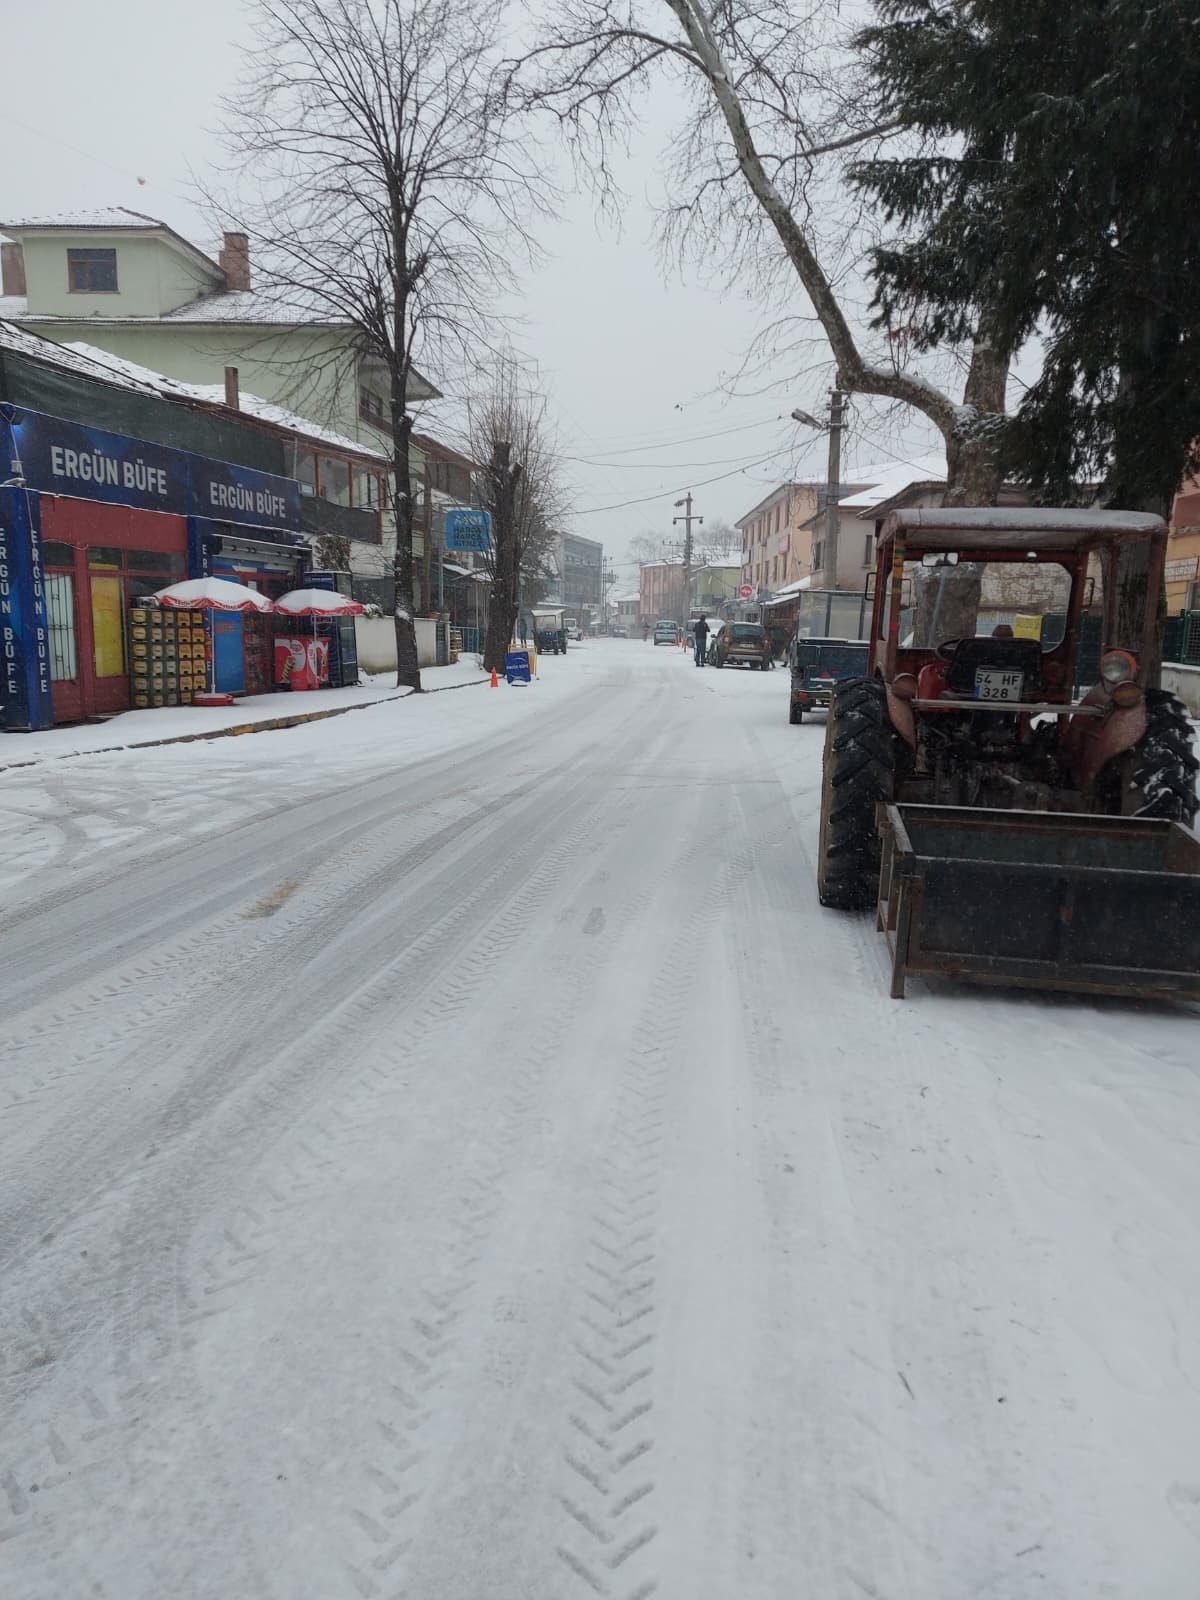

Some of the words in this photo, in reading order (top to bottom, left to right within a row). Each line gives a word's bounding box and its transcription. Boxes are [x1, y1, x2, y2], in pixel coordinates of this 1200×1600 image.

[50, 446, 119, 486] ERGÜN
[123, 458, 168, 495] BÜFE
[210, 481, 254, 512] ERGÜN
[256, 488, 286, 518] BÜFE
[30, 530, 43, 615] ERGÜN
[37, 627, 48, 693] BÜFE
[3, 627, 17, 694] BÜFE
[976, 673, 992, 684] 54
[1002, 674, 1020, 686] HF
[983, 687, 1009, 699] 328
